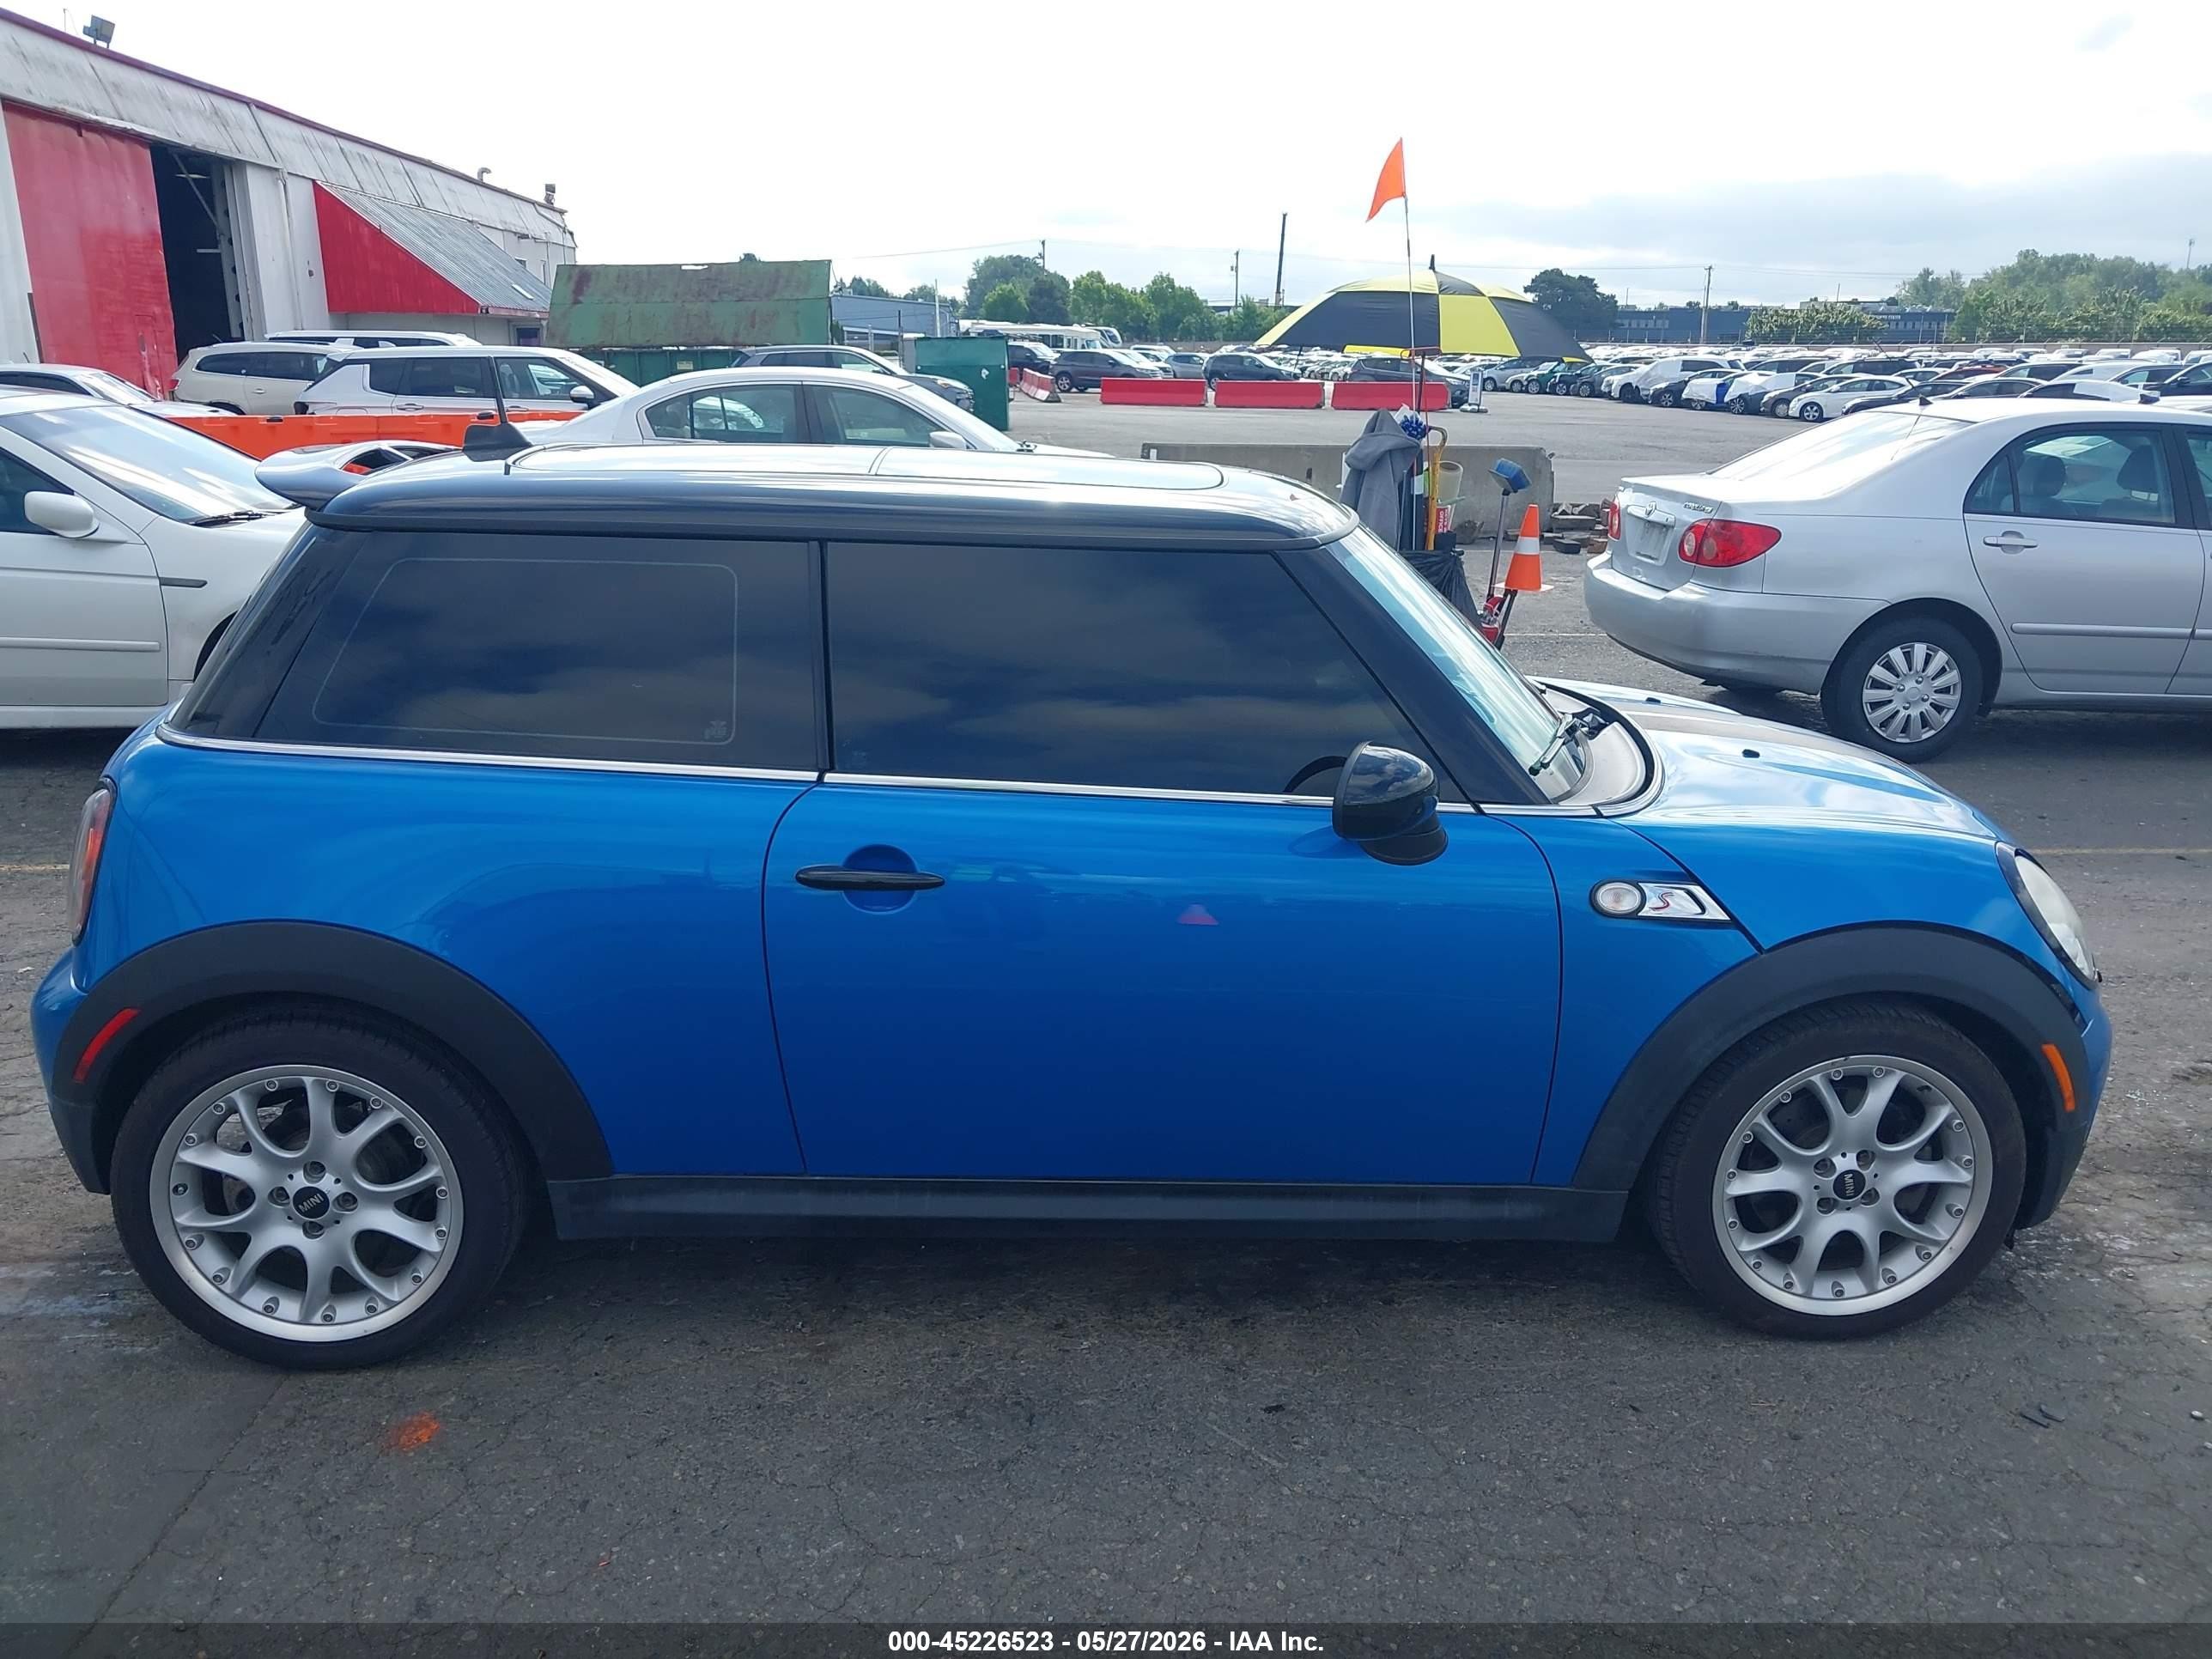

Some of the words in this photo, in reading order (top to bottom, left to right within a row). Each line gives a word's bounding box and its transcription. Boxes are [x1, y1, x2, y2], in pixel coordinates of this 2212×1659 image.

[1649, 891, 1675, 912] S
[1844, 1173, 1856, 1197] MINI
[298, 1193, 325, 1212] MINI
